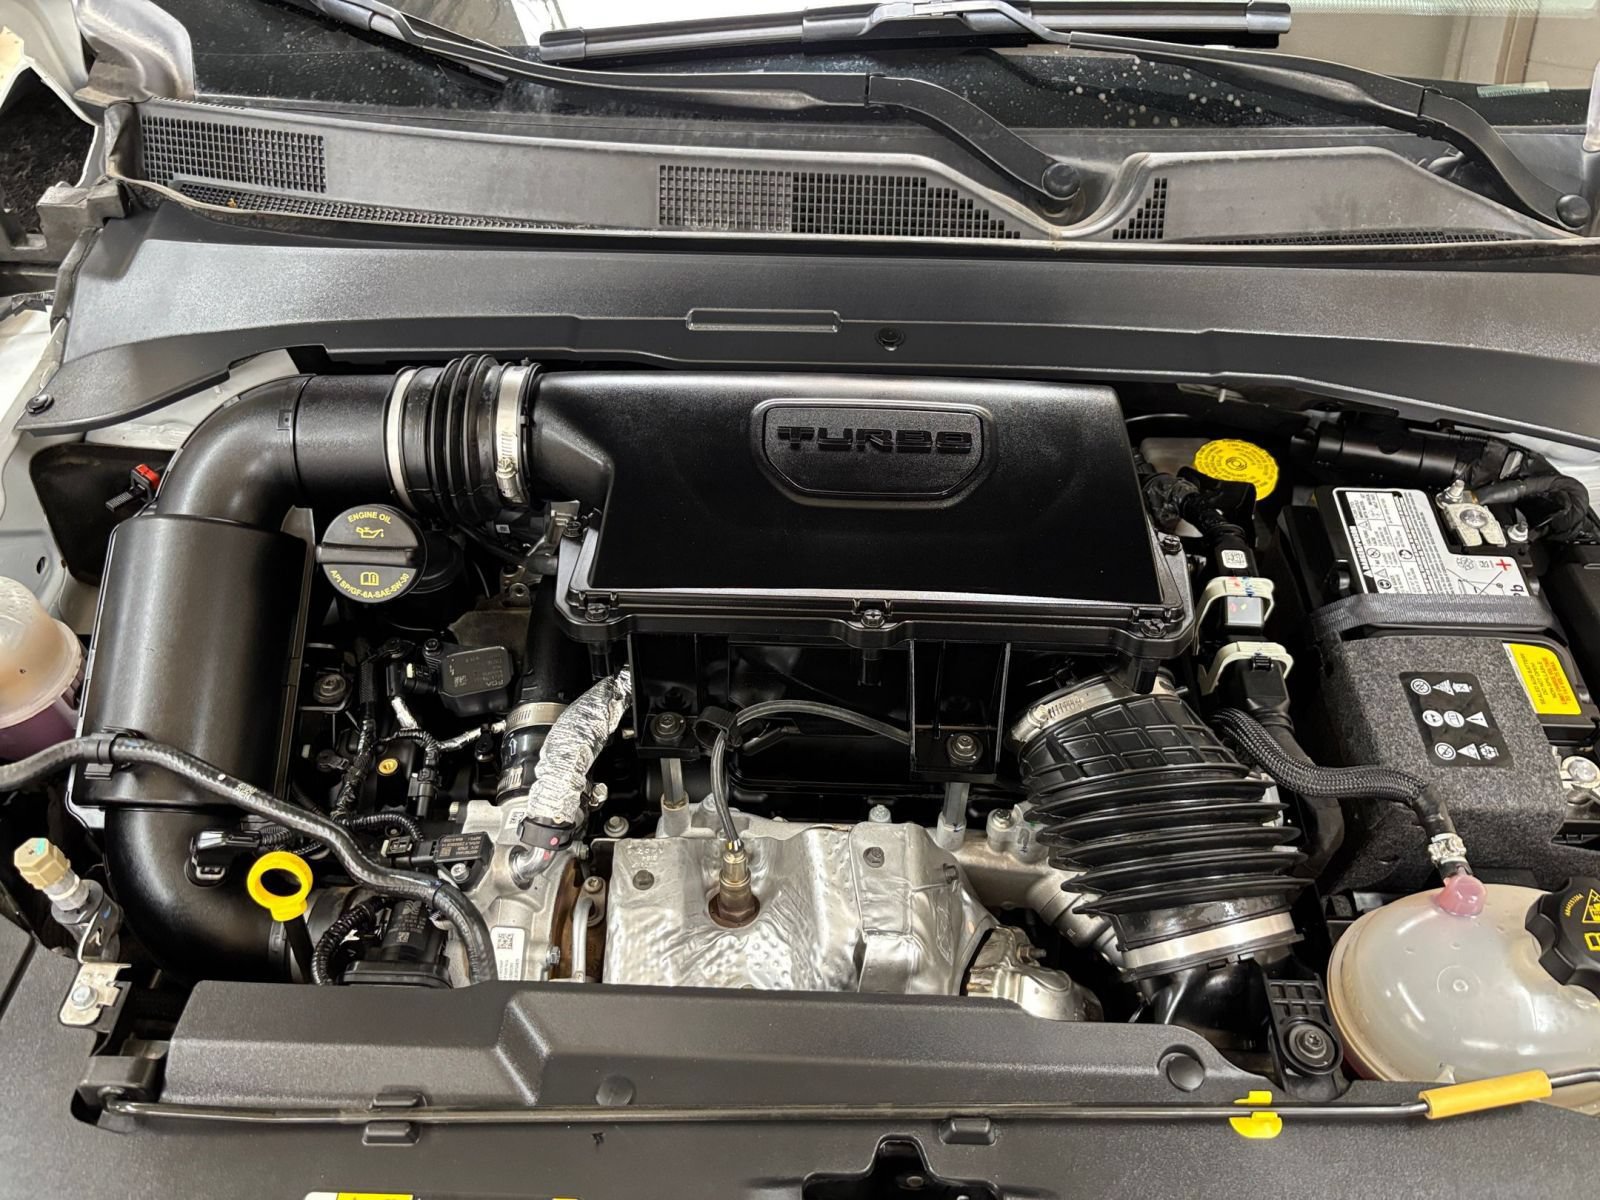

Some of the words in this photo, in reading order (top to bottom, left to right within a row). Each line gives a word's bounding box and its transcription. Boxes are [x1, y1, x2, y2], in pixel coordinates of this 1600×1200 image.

[777, 425, 973, 454] TURBO
[347, 511, 378, 524] ENGINE
[379, 513, 392, 525] OIL
[330, 570, 343, 583] API
